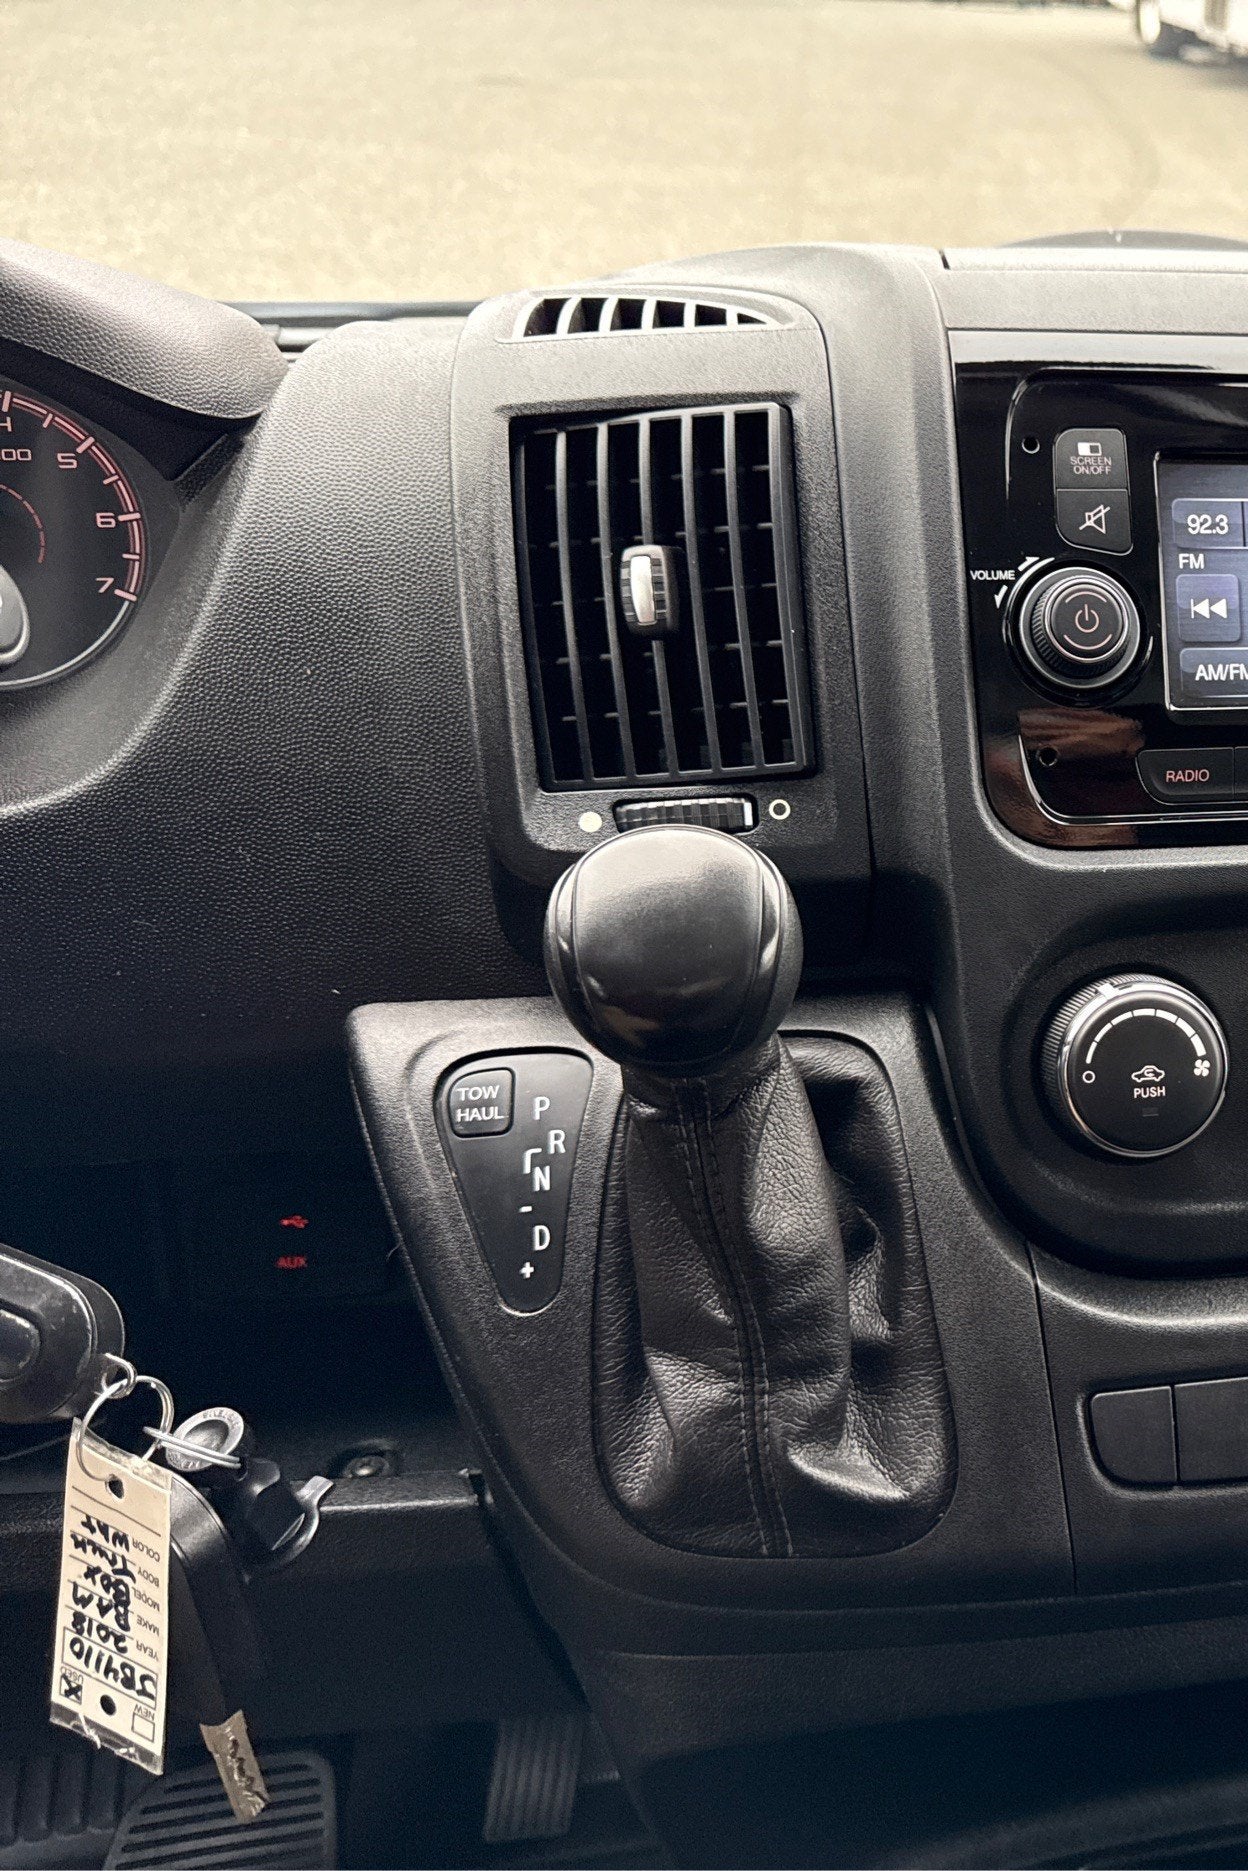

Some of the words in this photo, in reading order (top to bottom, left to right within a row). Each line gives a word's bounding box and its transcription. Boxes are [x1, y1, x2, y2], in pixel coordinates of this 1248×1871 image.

[56, 452, 78, 469] 5
[1069, 456, 1112, 466] SCREEN
[1073, 465, 1112, 475] ON/OFF
[95, 512, 116, 529] 6
[1186, 514, 1229, 535] 92.3
[1178, 553, 1206, 570] FM
[970, 569, 1016, 580] VOLUME
[95, 577, 115, 594] 7
[1165, 769, 1210, 783] RADIO
[456, 1085, 499, 1101] TOW
[1133, 1086, 1166, 1098] PUSH
[457, 1106, 506, 1123] HAUL
[533, 1096, 550, 1121] P
[548, 1129, 566, 1155] R
[532, 1165, 551, 1192] N
[532, 1224, 551, 1251] D
[277, 1256, 307, 1269] AUX
[132, 1538, 161, 1563] COLOR
[137, 1567, 160, 1588] BODY
[132, 1587, 161, 1612] MODEL
[136, 1615, 160, 1637] MAKE
[136, 1640, 159, 1661] YEAR
[60, 1667, 84, 1685] USED
[69, 1636, 157, 1701] JB4110
[134, 1704, 155, 1721] NEW
